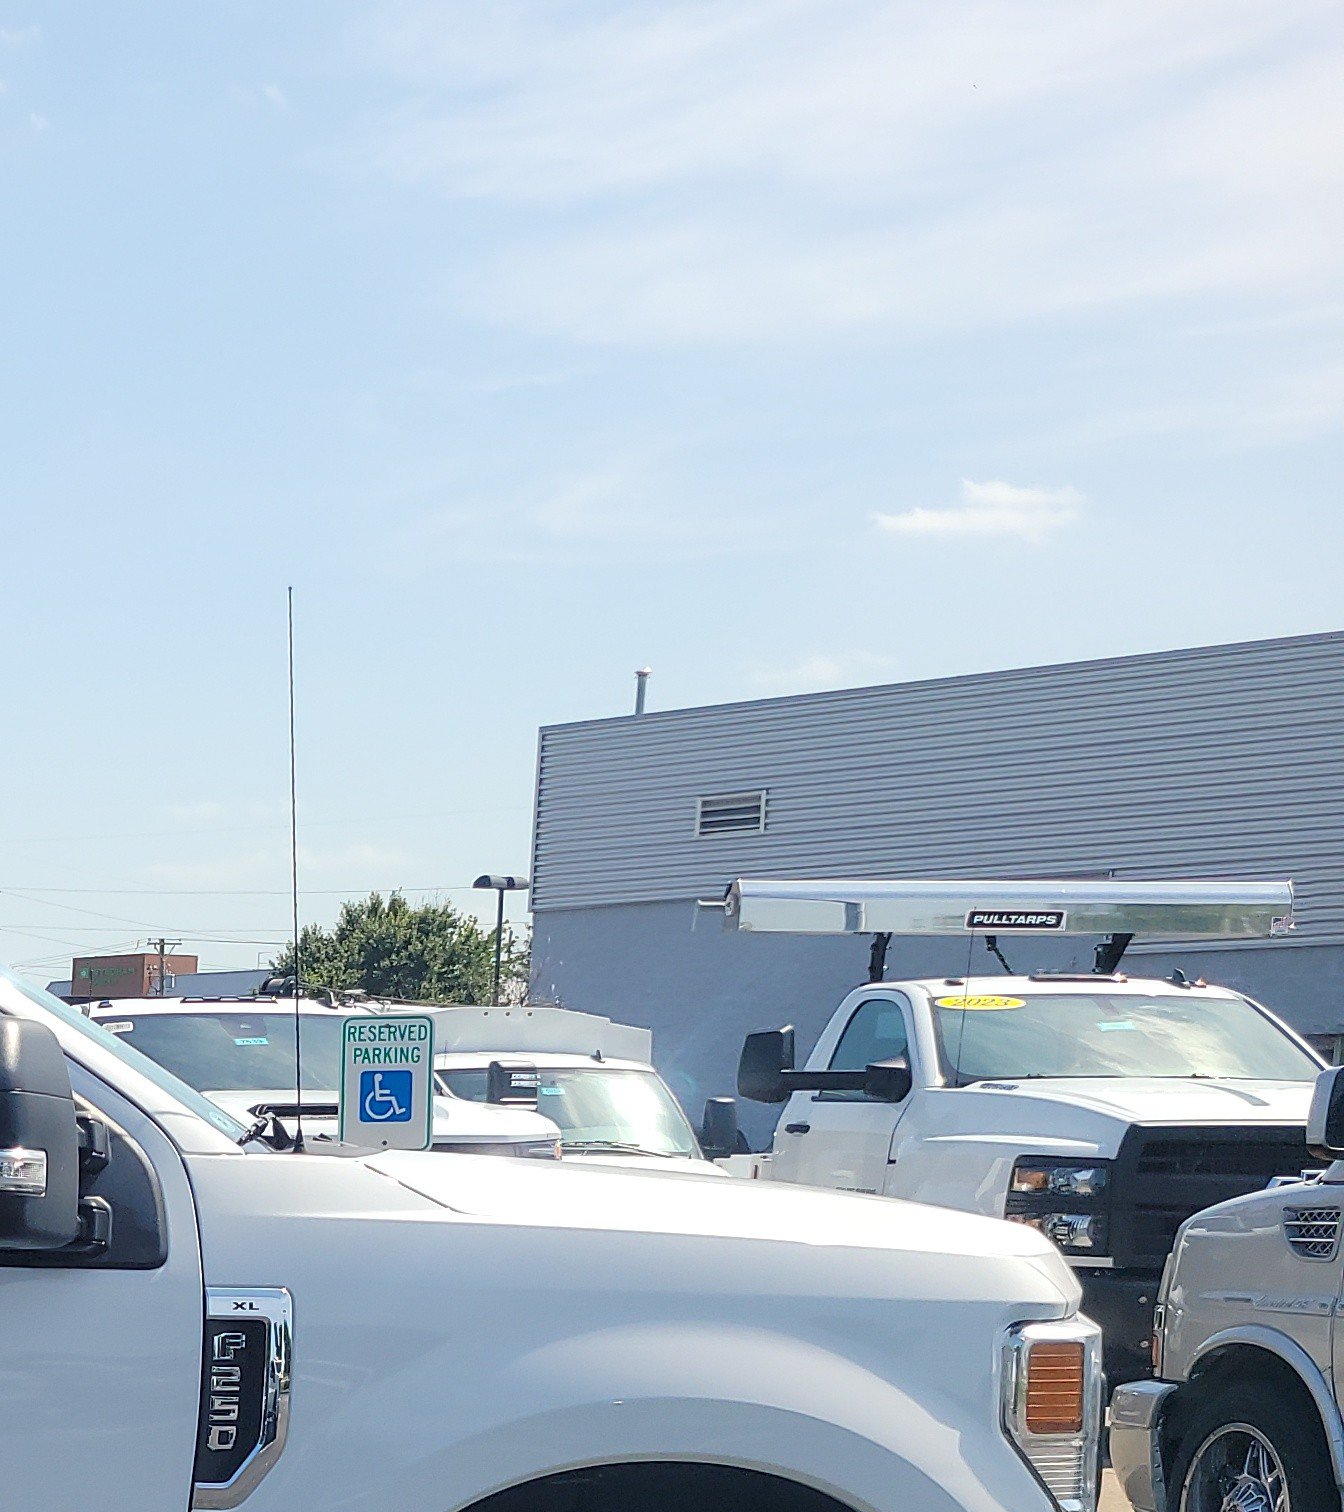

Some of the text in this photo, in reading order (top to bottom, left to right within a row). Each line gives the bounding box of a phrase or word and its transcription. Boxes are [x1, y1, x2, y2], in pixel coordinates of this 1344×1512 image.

[972, 914, 1058, 925] PULLTARPS
[952, 995, 1010, 1007] 2023
[347, 1024, 428, 1042] RESERVED
[353, 1046, 421, 1064] PARKING
[231, 1301, 260, 1311] XL
